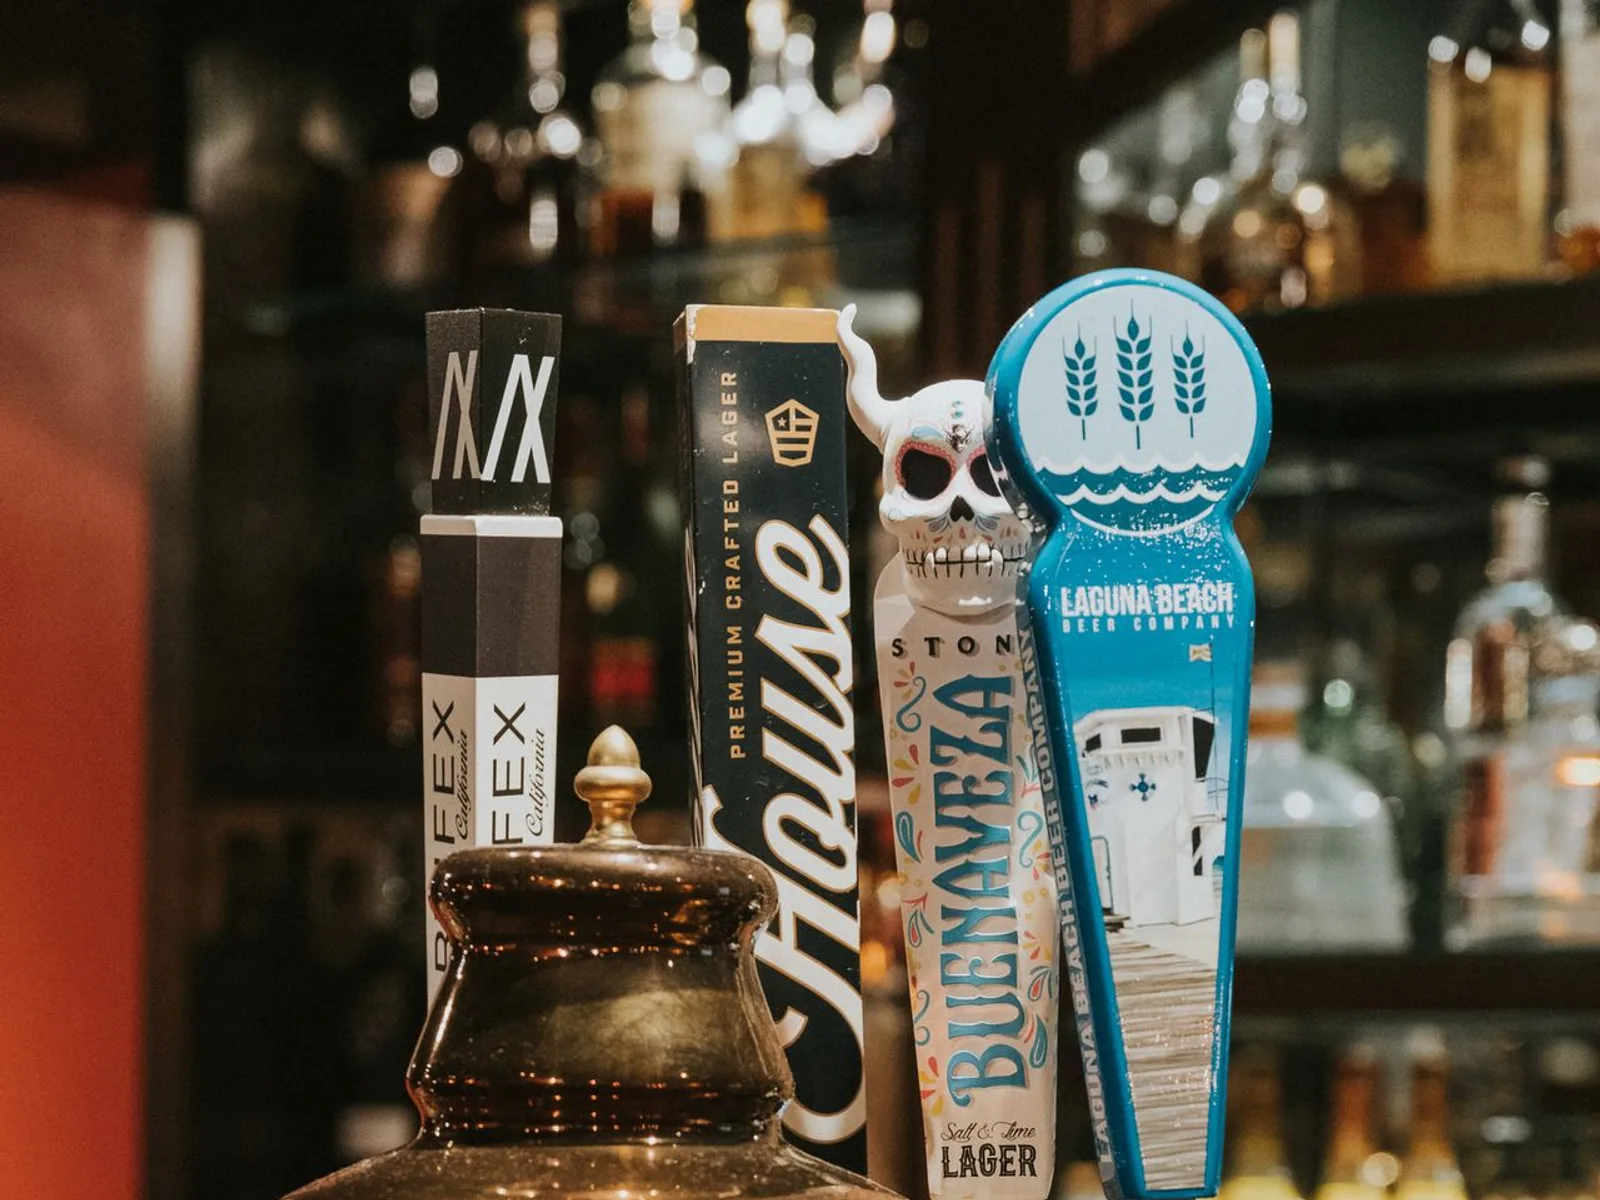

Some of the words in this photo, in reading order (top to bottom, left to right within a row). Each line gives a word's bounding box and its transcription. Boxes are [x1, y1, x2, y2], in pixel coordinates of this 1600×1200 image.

[720, 371, 738, 465] LAGER
[723, 479, 742, 611] CRAFTED
[1060, 584, 1153, 617] LAGUNA
[1154, 581, 1235, 614] BEACH
[891, 634, 1012, 658] STON
[1062, 617, 1116, 633] BEER
[1133, 614, 1235, 631] COMPANY
[724, 624, 747, 760] PREMIUM
[1018, 628, 1059, 793] COMPANY
[454, 728, 472, 841] California
[491, 701, 526, 845] FEX
[525, 728, 549, 837] California
[929, 674, 1030, 1109] BUENAVEZA
[1046, 800, 1071, 892] BEER
[1058, 905, 1091, 1016] BEACH
[940, 1122, 978, 1143] Salt
[941, 1143, 1038, 1179] LAGER
